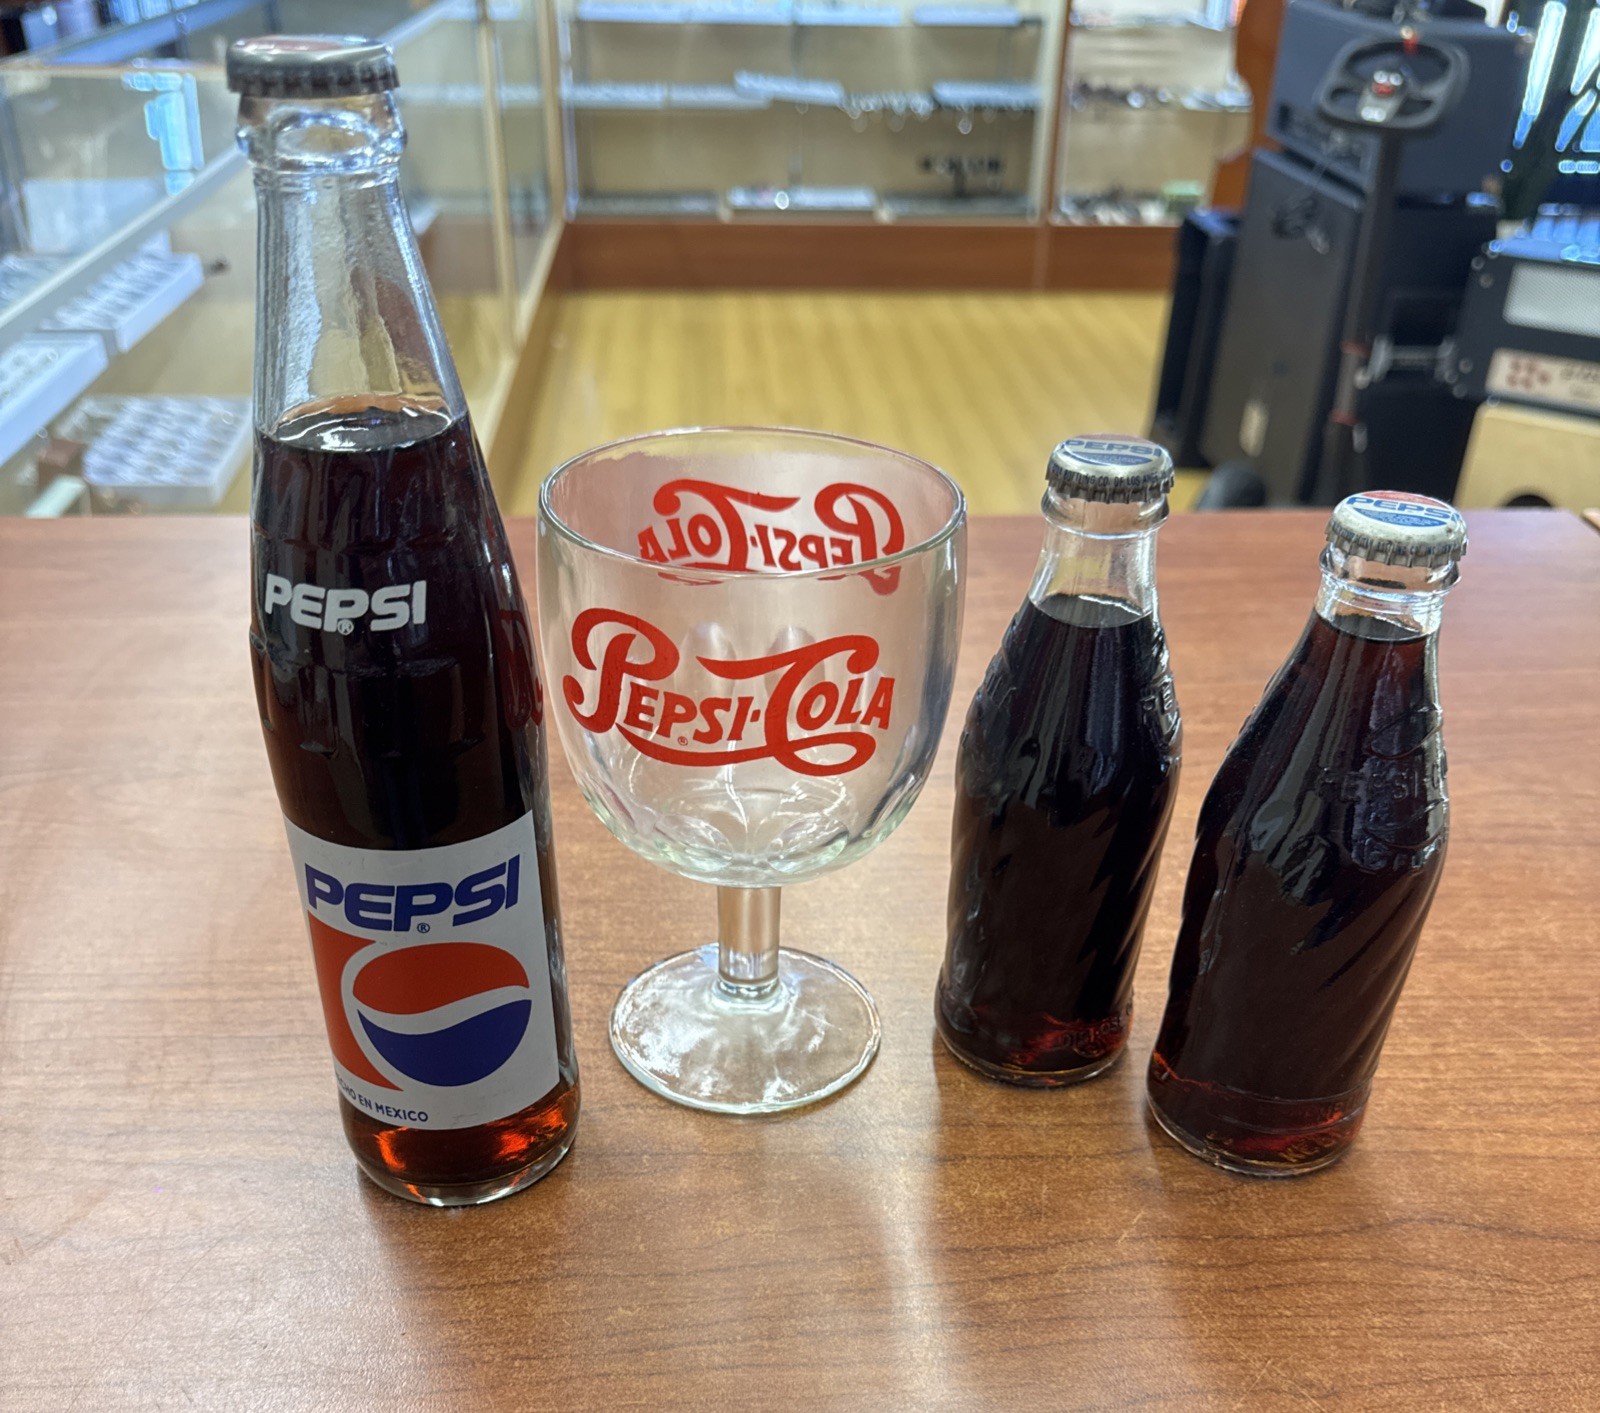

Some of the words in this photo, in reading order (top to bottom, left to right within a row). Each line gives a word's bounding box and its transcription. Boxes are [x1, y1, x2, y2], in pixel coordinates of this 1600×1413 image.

[1060, 439, 1162, 457] PEPSI
[1126, 475, 1140, 487] LOS
[1345, 496, 1460, 522] PEPSI
[264, 573, 427, 633] PEPSI
[304, 853, 520, 932] PEPSI
[358, 1093, 373, 1110] EN
[374, 1102, 429, 1122] MEXICO
